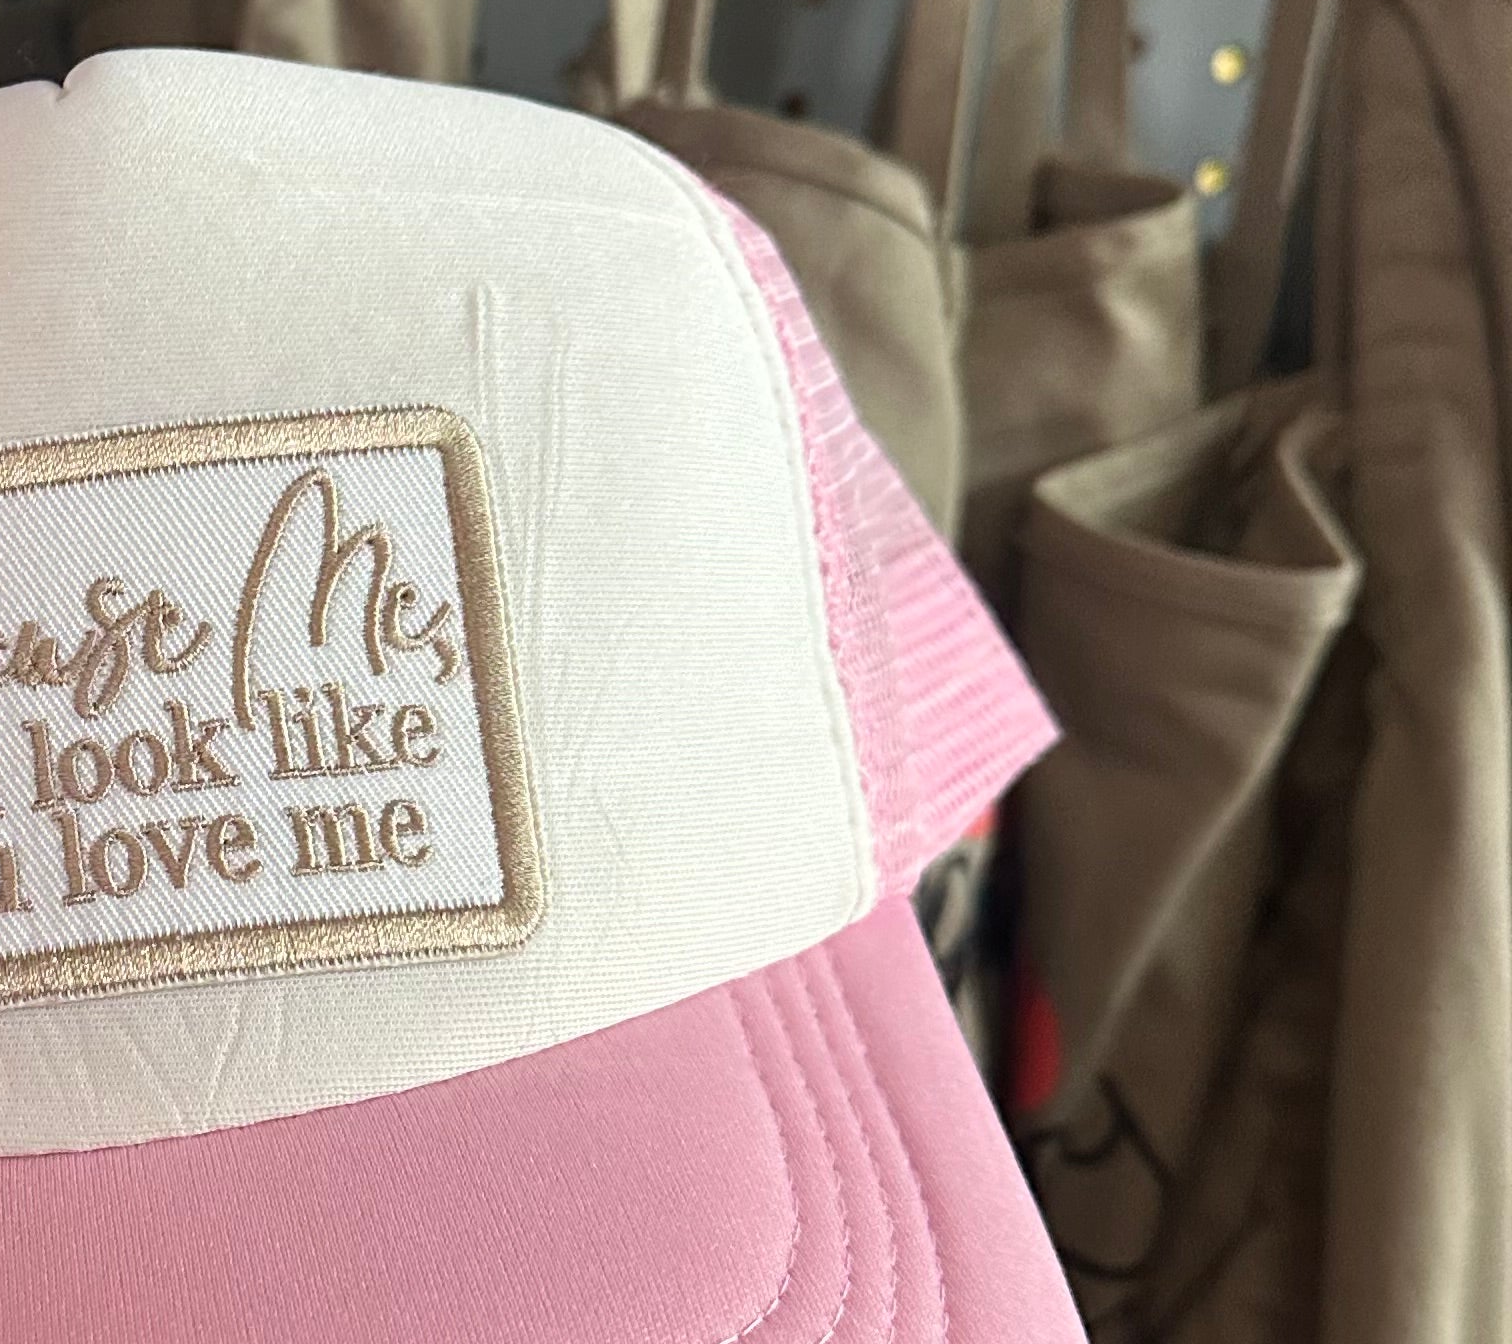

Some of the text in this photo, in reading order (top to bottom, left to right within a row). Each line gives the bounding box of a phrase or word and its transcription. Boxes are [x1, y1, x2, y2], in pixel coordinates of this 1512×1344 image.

[232, 465, 462, 731] Me,
[23, 699, 241, 810] look
[256, 684, 442, 780] like
[56, 808, 260, 907] love
[289, 796, 434, 878] me
